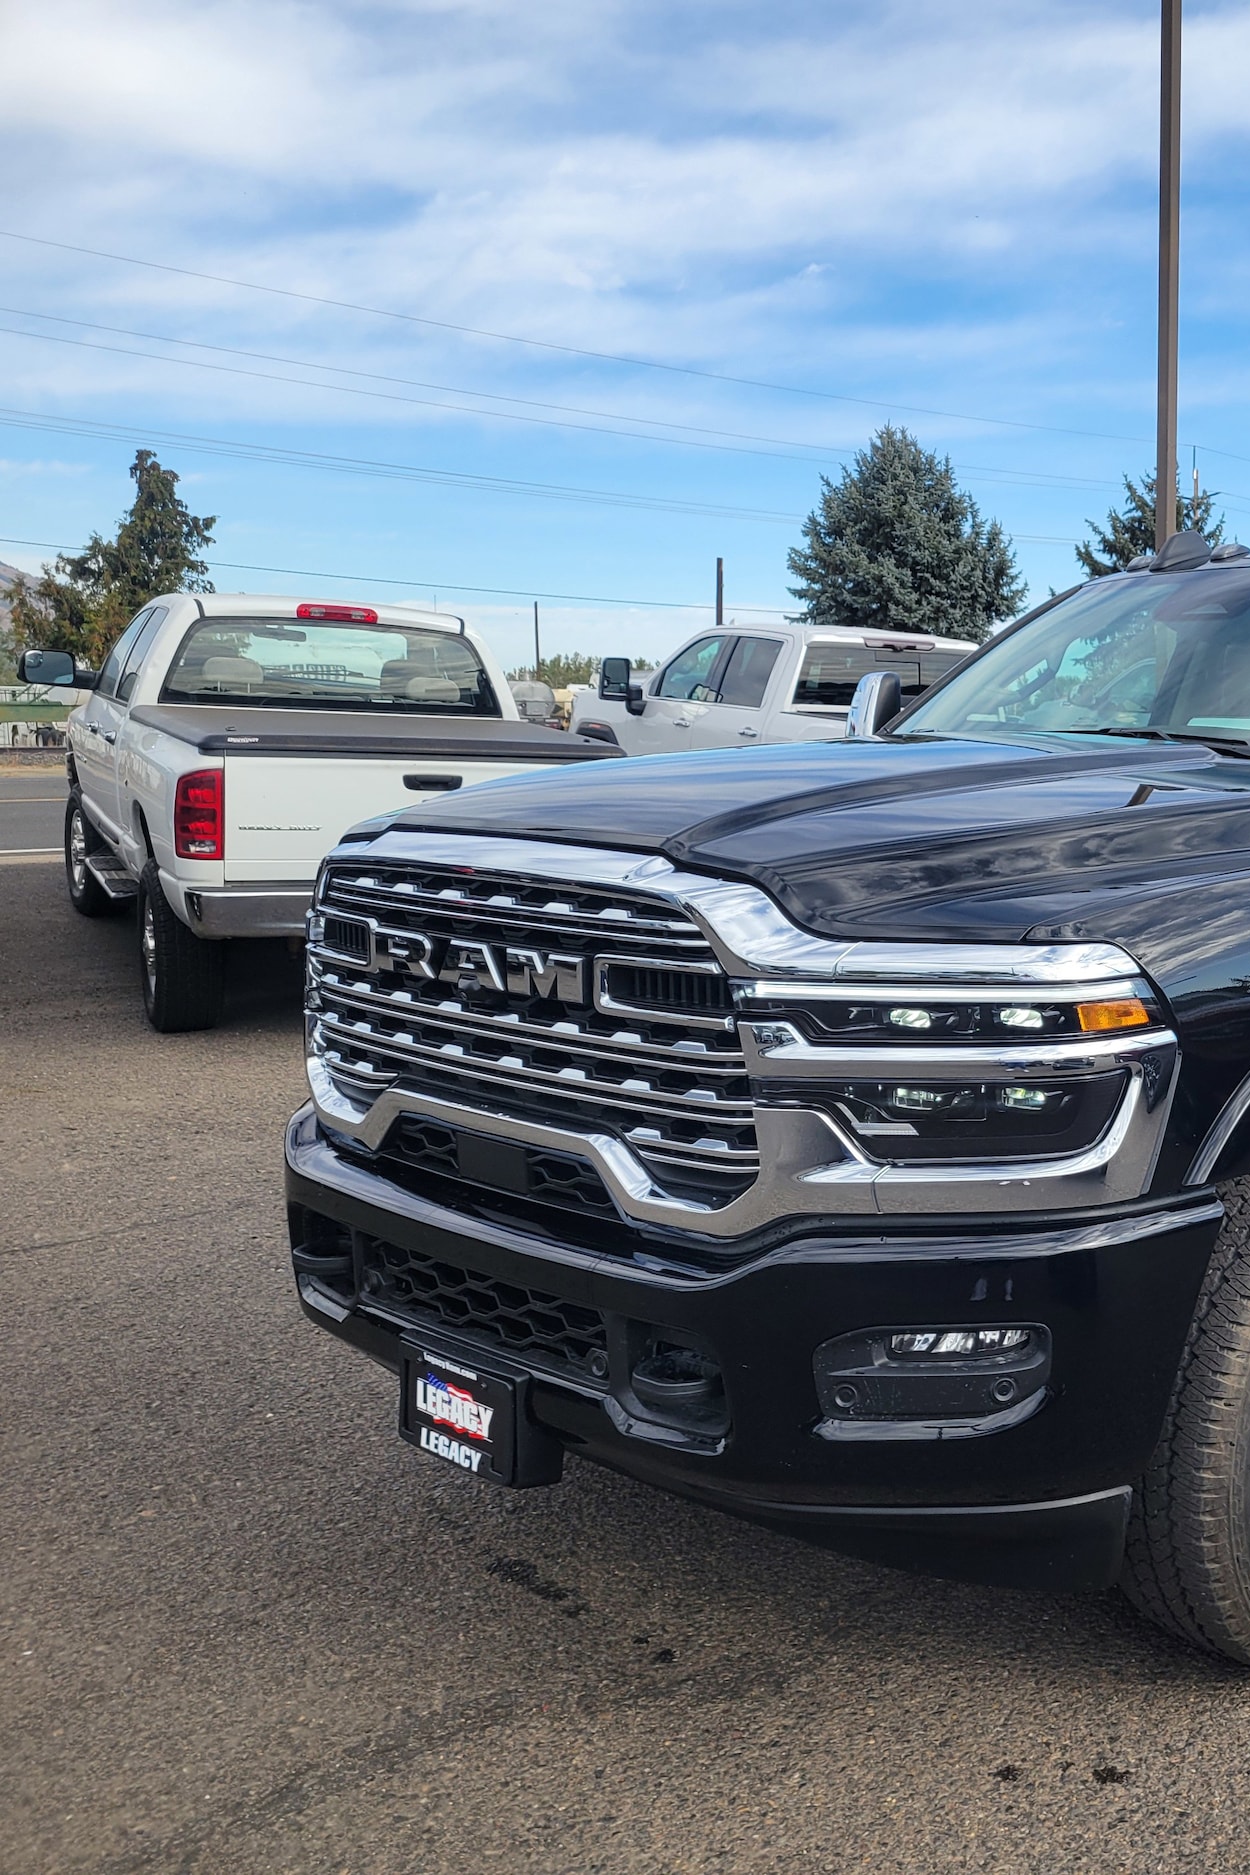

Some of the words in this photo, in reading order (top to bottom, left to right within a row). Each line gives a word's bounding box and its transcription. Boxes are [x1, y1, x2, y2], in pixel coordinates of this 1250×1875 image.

[373, 924, 587, 1004] RAM
[416, 1379, 494, 1439] LEGACY
[420, 1426, 482, 1473] LEGACY
